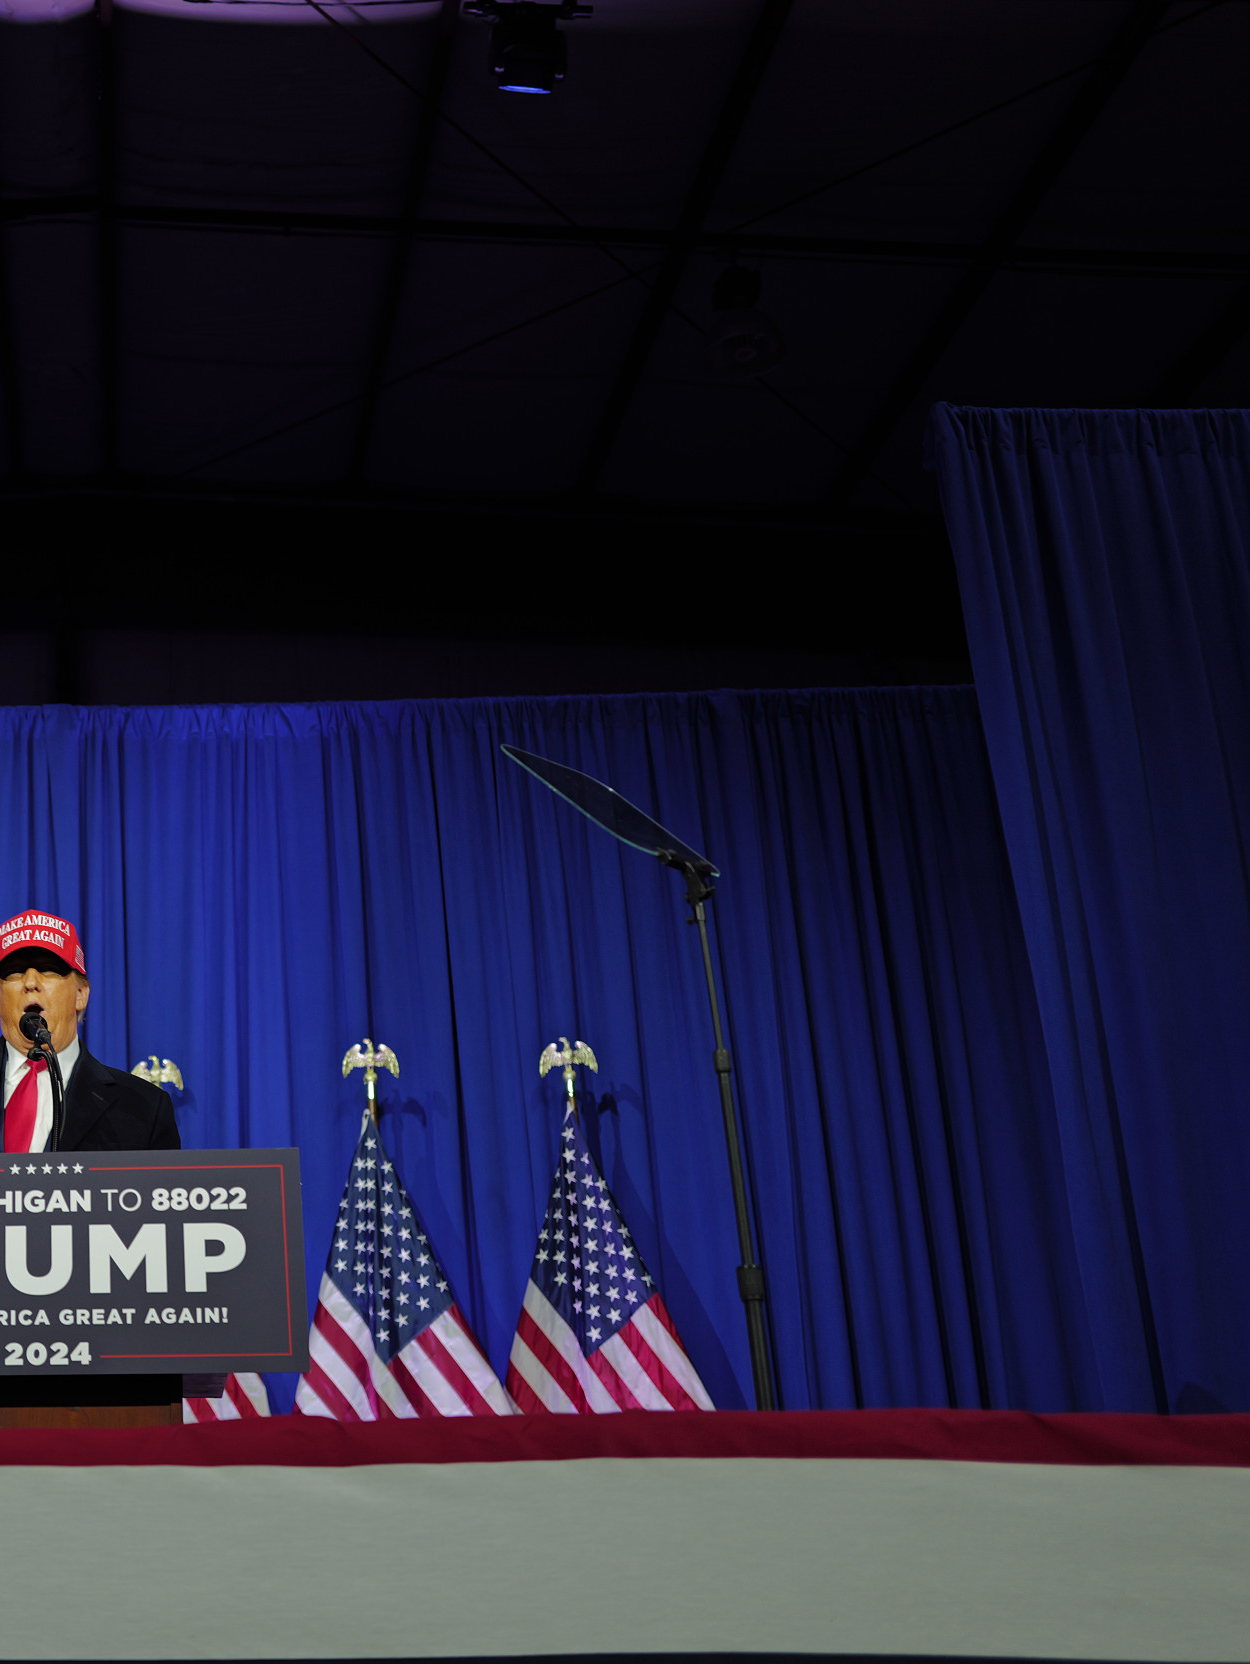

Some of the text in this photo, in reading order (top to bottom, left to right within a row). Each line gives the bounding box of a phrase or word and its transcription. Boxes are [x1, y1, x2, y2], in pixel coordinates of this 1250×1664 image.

[24, 914, 71, 937] AMERICA
[1, 929, 65, 949] GREAT AGAIN
[101, 1188, 142, 1212] TO
[151, 1187, 248, 1212] 88022
[59, 1307, 136, 1326] GREAT
[144, 1306, 229, 1325] AGAIN!
[4, 1341, 92, 1366] 2024
